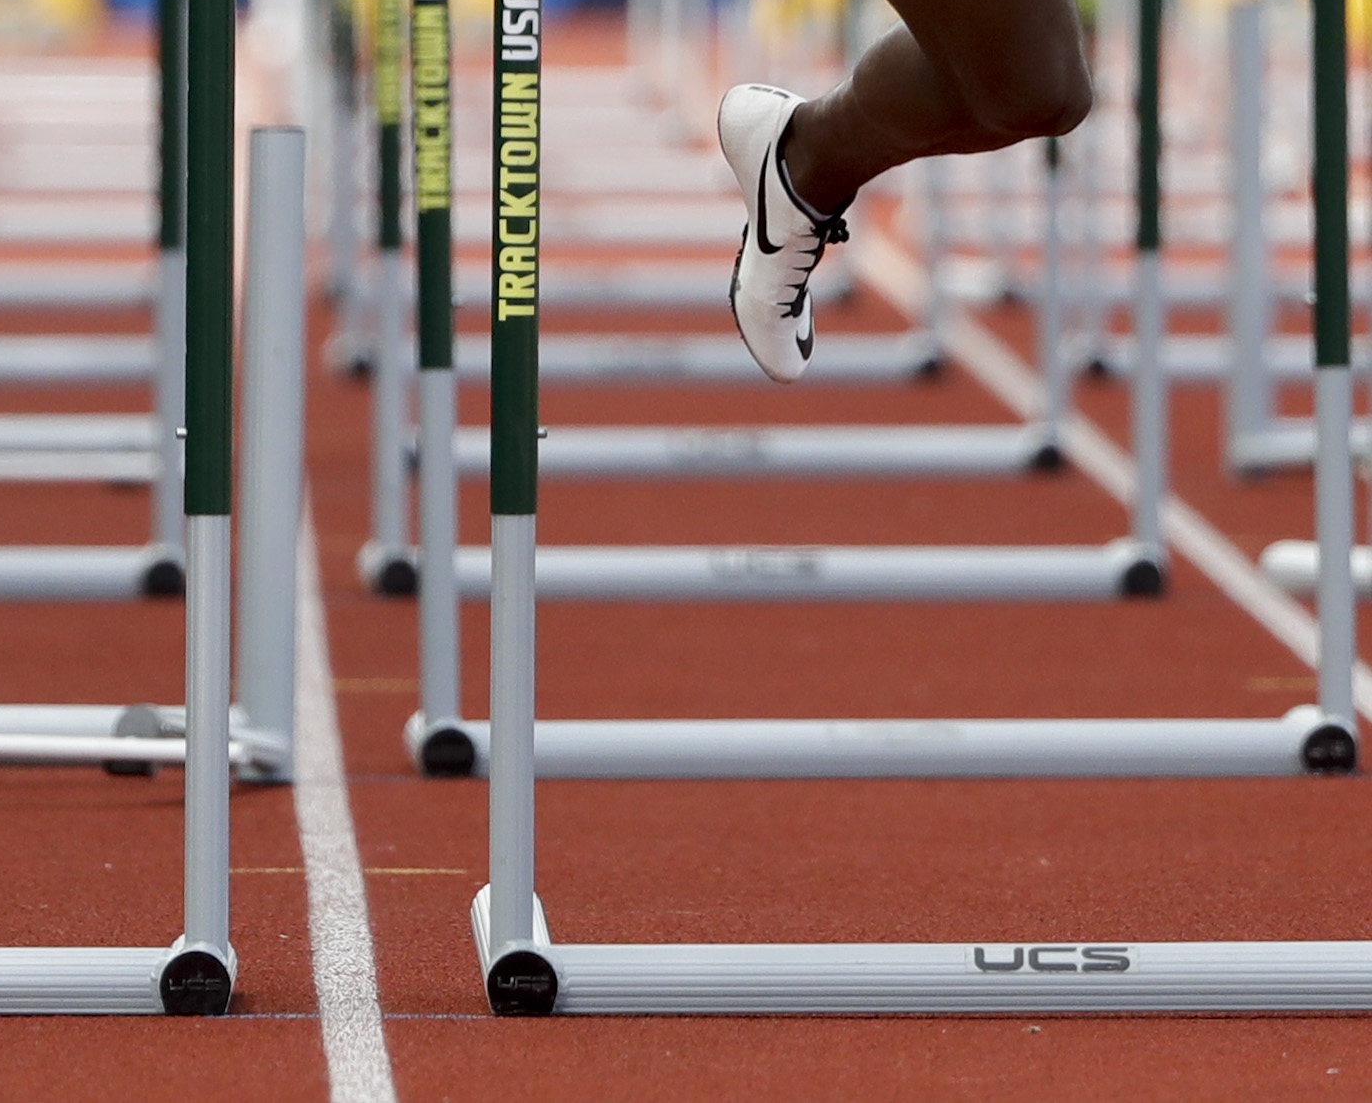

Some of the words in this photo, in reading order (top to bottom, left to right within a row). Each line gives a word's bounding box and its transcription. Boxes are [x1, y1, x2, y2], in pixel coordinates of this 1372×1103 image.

[498, 72, 539, 321] TRACKTOWN
[974, 947, 1130, 972] UCS
[169, 978, 223, 990] UCS
